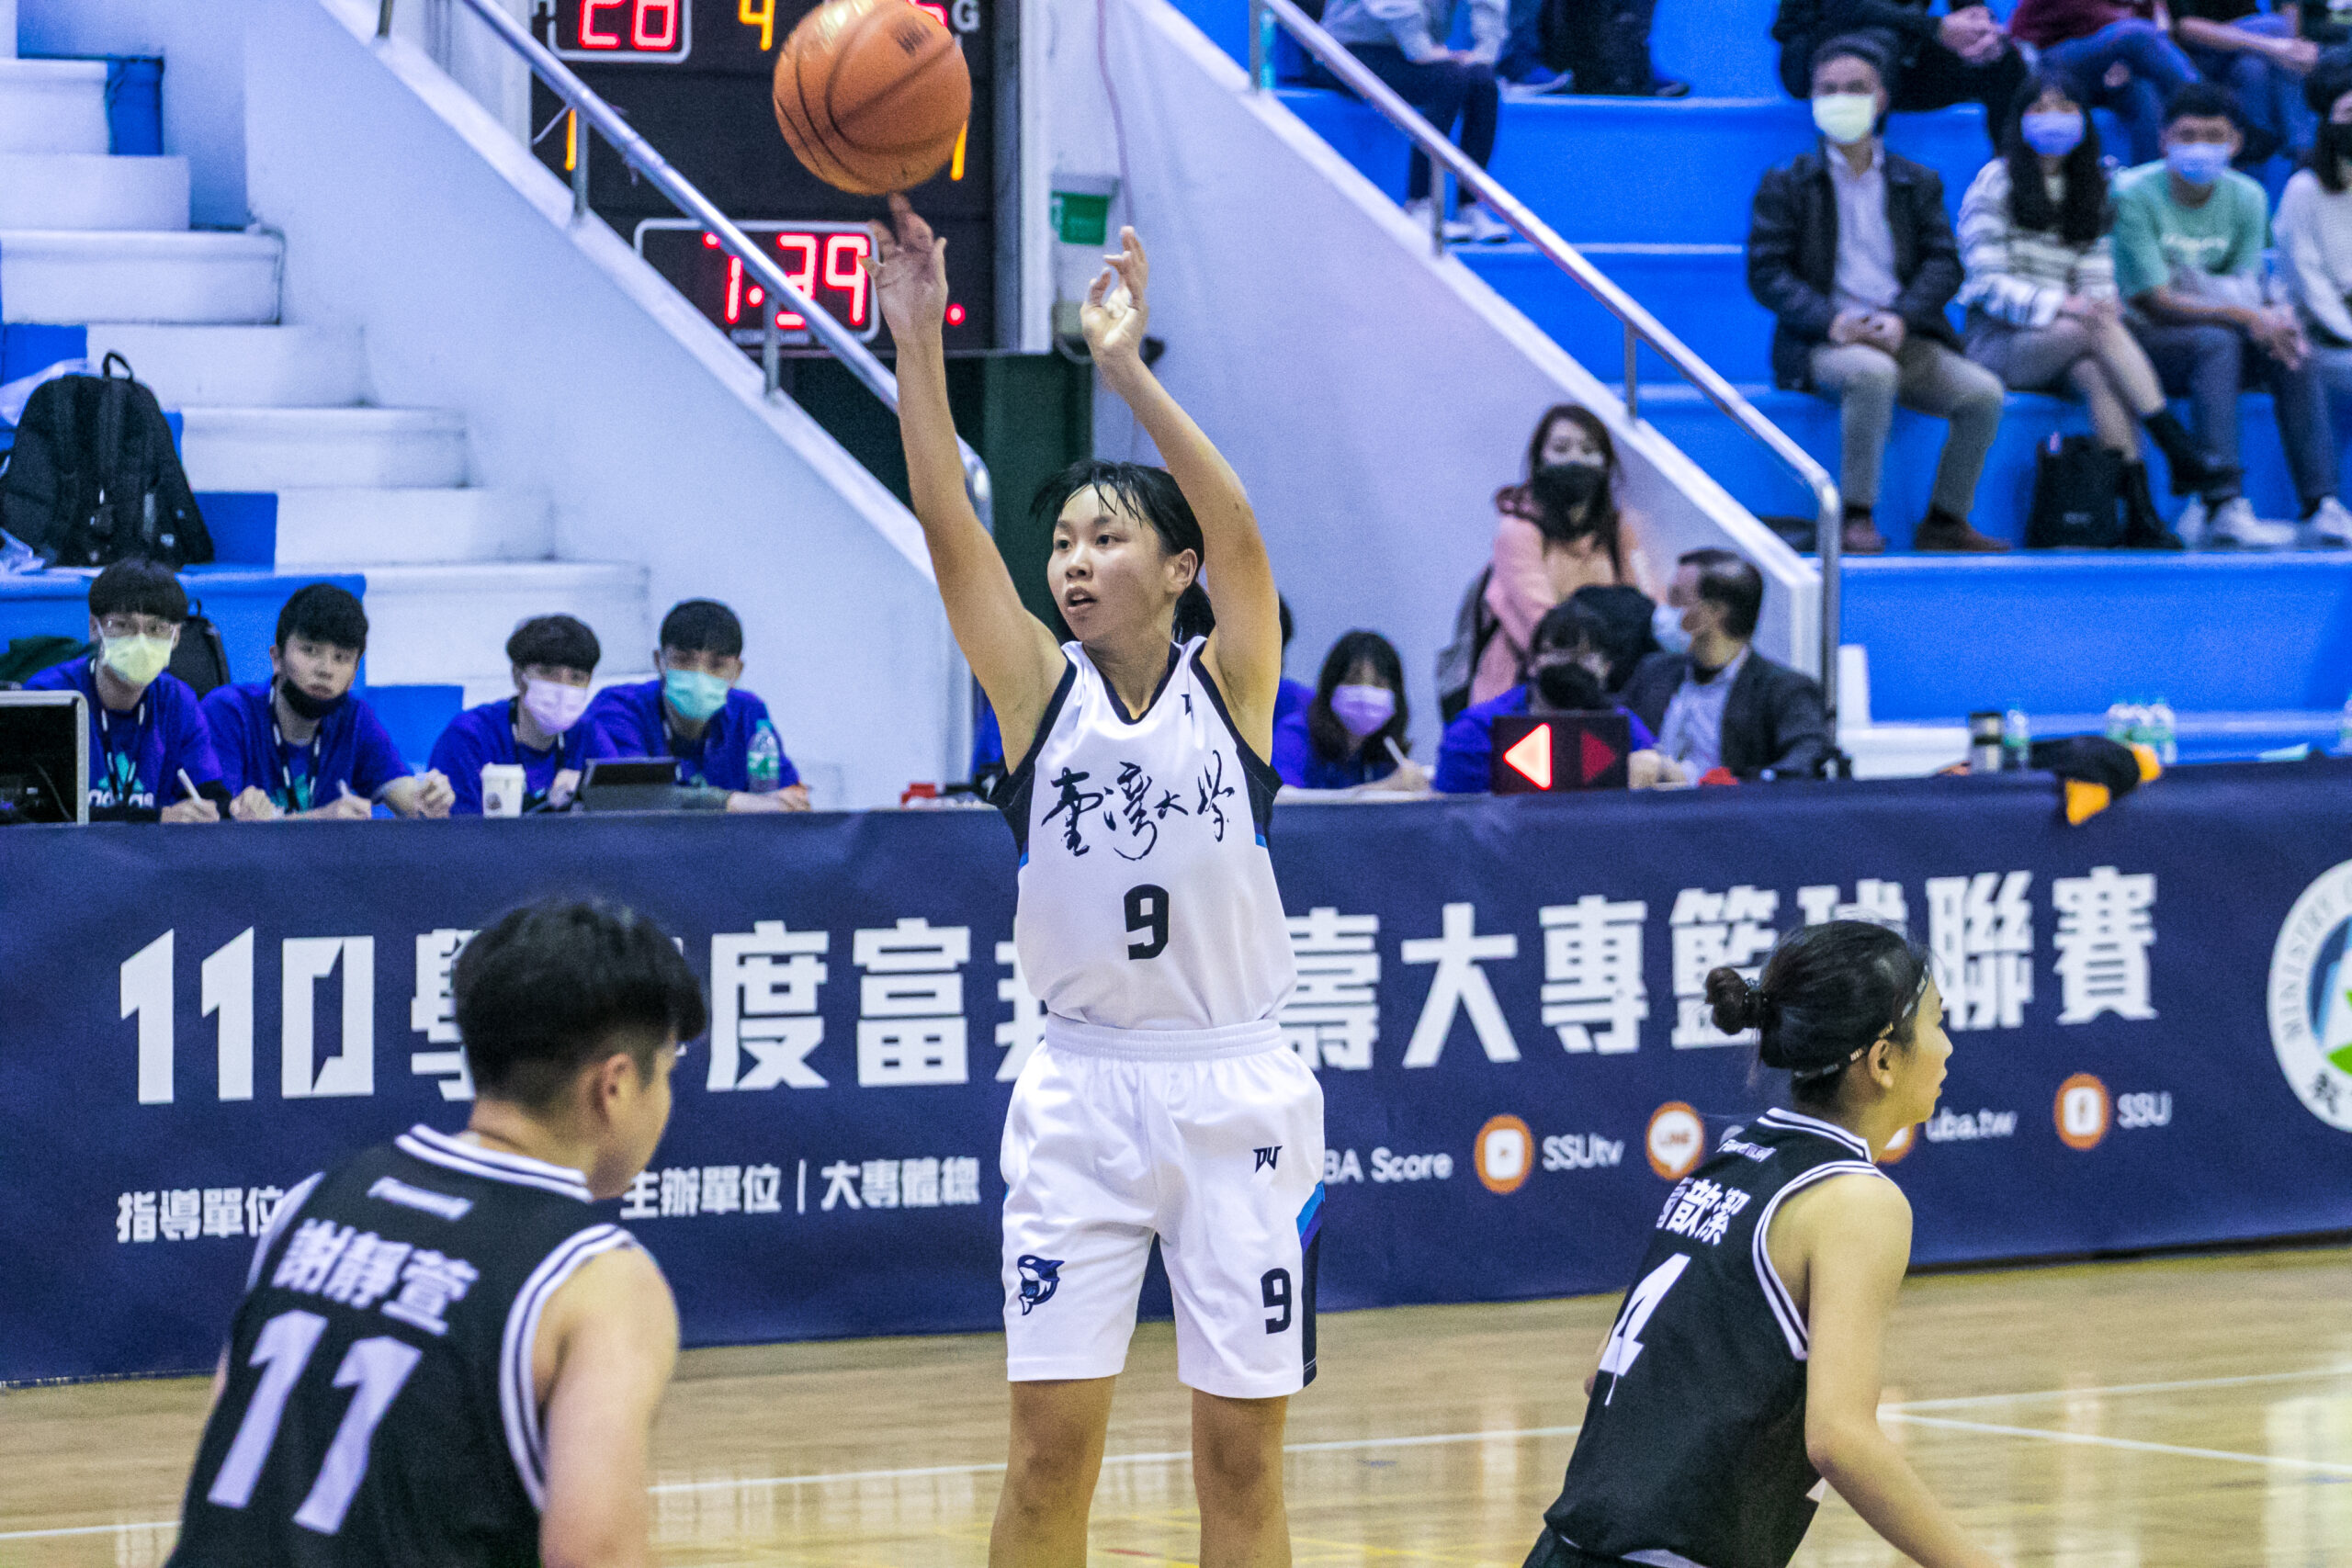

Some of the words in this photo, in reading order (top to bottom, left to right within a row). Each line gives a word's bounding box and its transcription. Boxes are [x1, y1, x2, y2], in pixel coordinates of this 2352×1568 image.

[1123, 883, 1170, 961] 9
[2117, 1091, 2173, 1130] SSU
[1323, 1148, 1365, 1186] BA
[1370, 1145, 1454, 1184] Score
[1260, 1267, 1293, 1335] 9
[207, 1308, 424, 1536] 11
